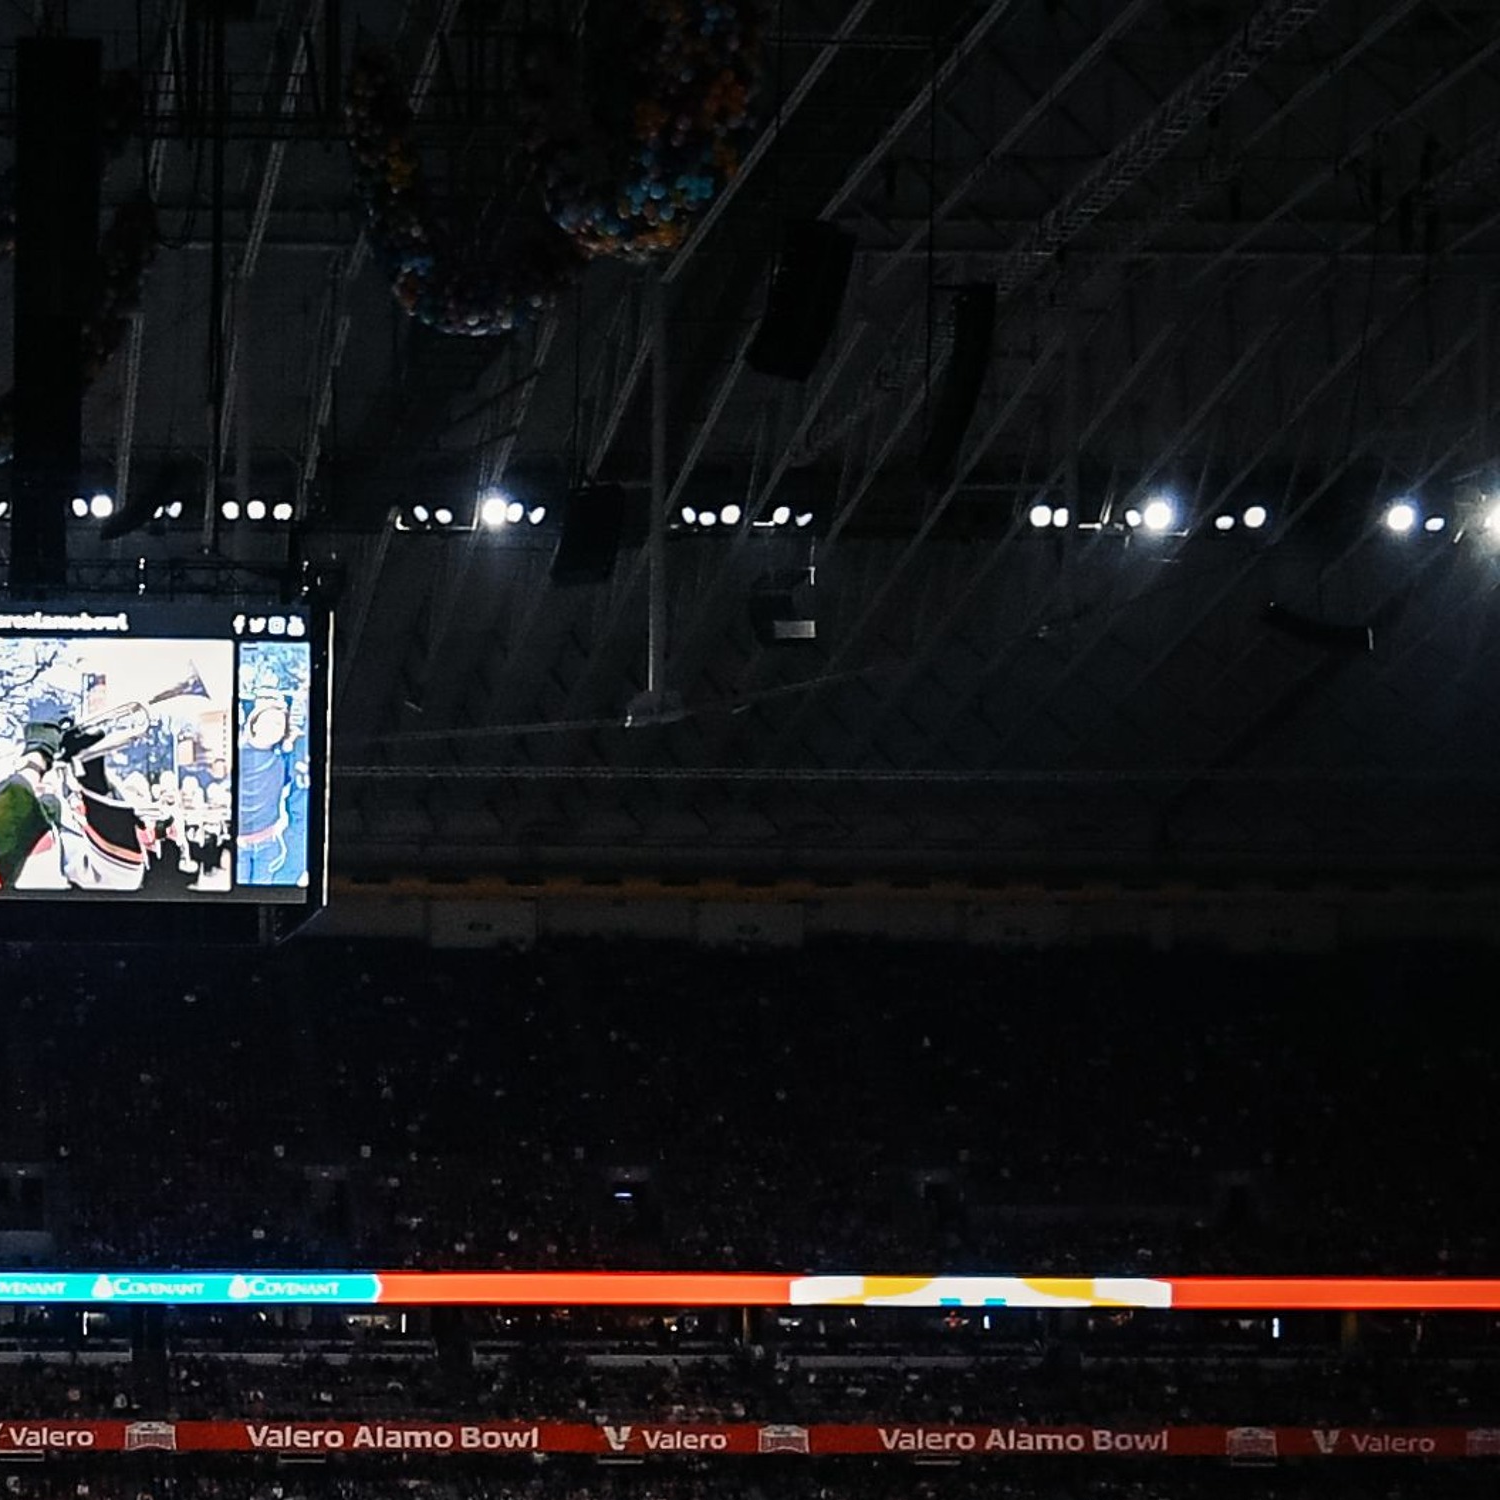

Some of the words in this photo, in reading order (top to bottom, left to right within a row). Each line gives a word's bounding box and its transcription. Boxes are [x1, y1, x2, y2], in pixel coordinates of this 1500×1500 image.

[9, 1426, 95, 1446] Valero
[246, 1426, 344, 1448] Valero
[353, 1426, 454, 1448] Alamo
[460, 1426, 539, 1448] Bowl
[642, 1430, 727, 1450] Valero
[878, 1429, 975, 1451] Valero
[985, 1429, 1084, 1451] Alamo
[1092, 1429, 1168, 1451] Bowl
[1351, 1434, 1436, 1452] Valero
